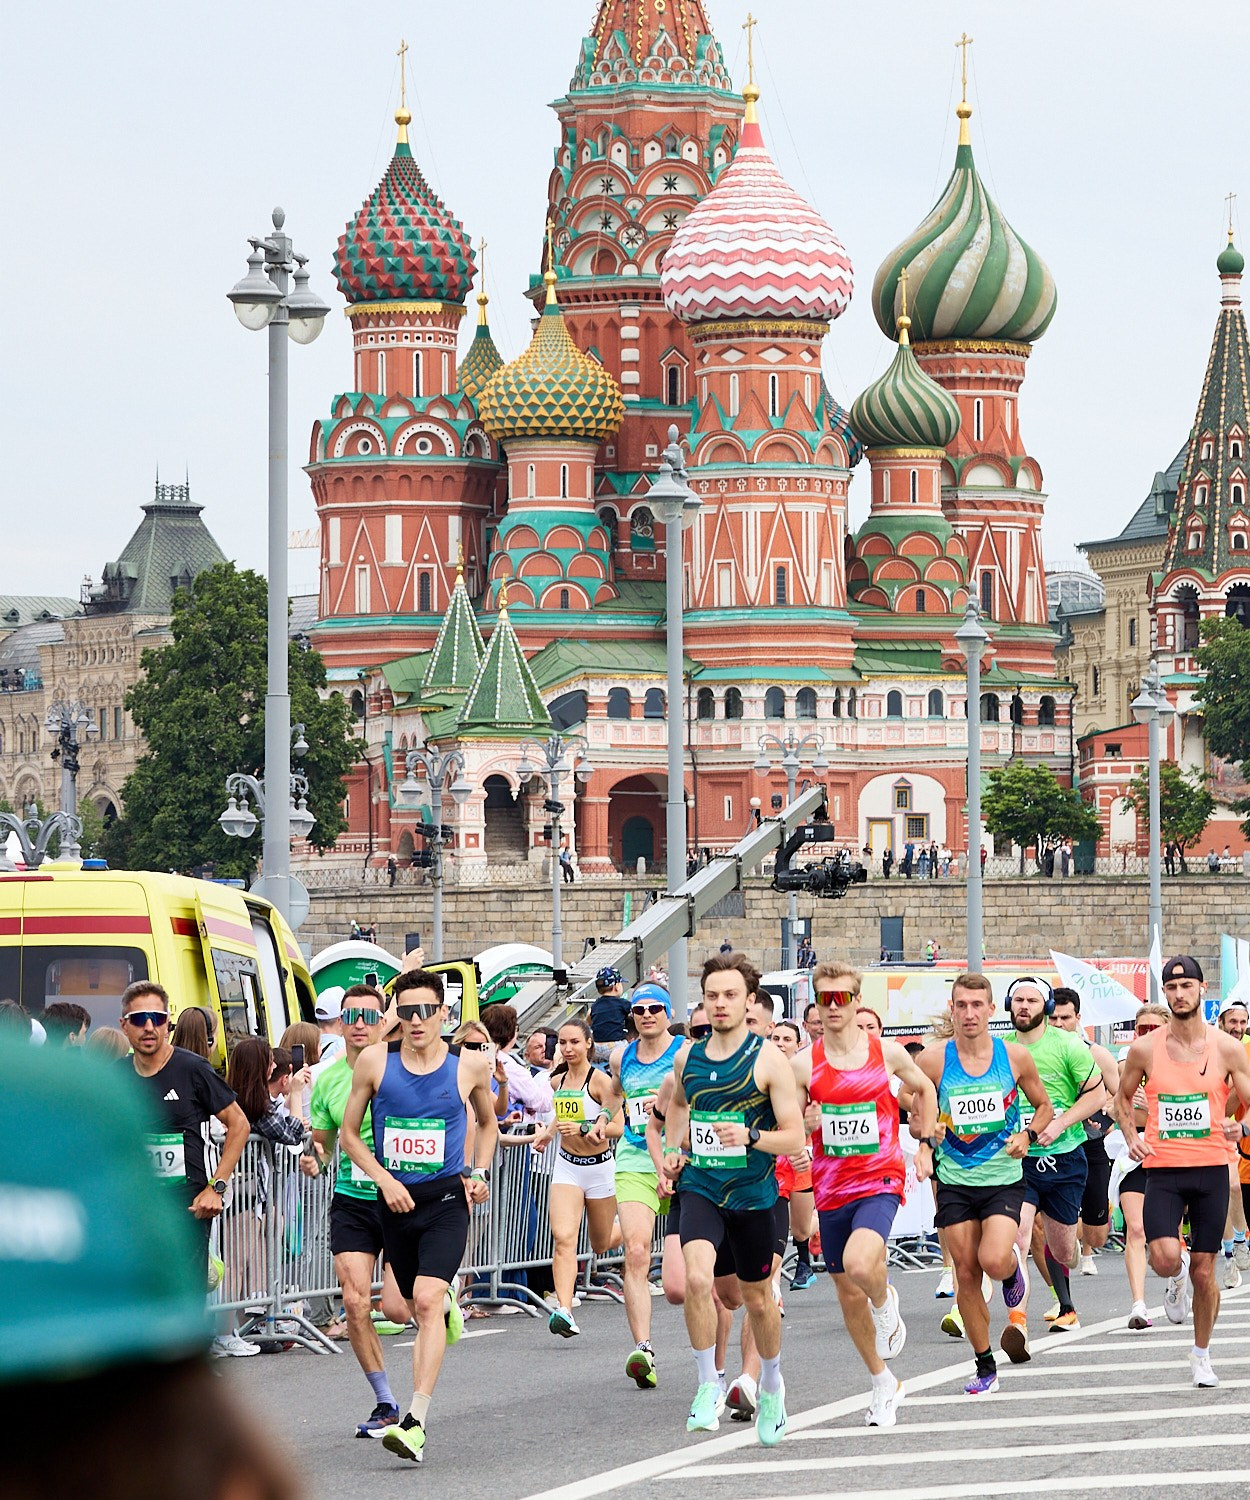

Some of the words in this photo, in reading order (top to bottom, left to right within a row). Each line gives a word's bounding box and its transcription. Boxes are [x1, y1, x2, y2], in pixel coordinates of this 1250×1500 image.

[1089, 973, 1112, 985] СБ
[883, 1026, 935, 1036] НАЦИОНАЛЬНЫЙ
[957, 1098, 996, 1115] 2006
[1165, 1106, 1203, 1122] 5686
[829, 1119, 870, 1136] 1576
[392, 1137, 437, 1156] 1053
[147, 1150, 175, 1167] 19
[391, 1159, 399, 1168] A
[572, 1156, 597, 1165] PRO
